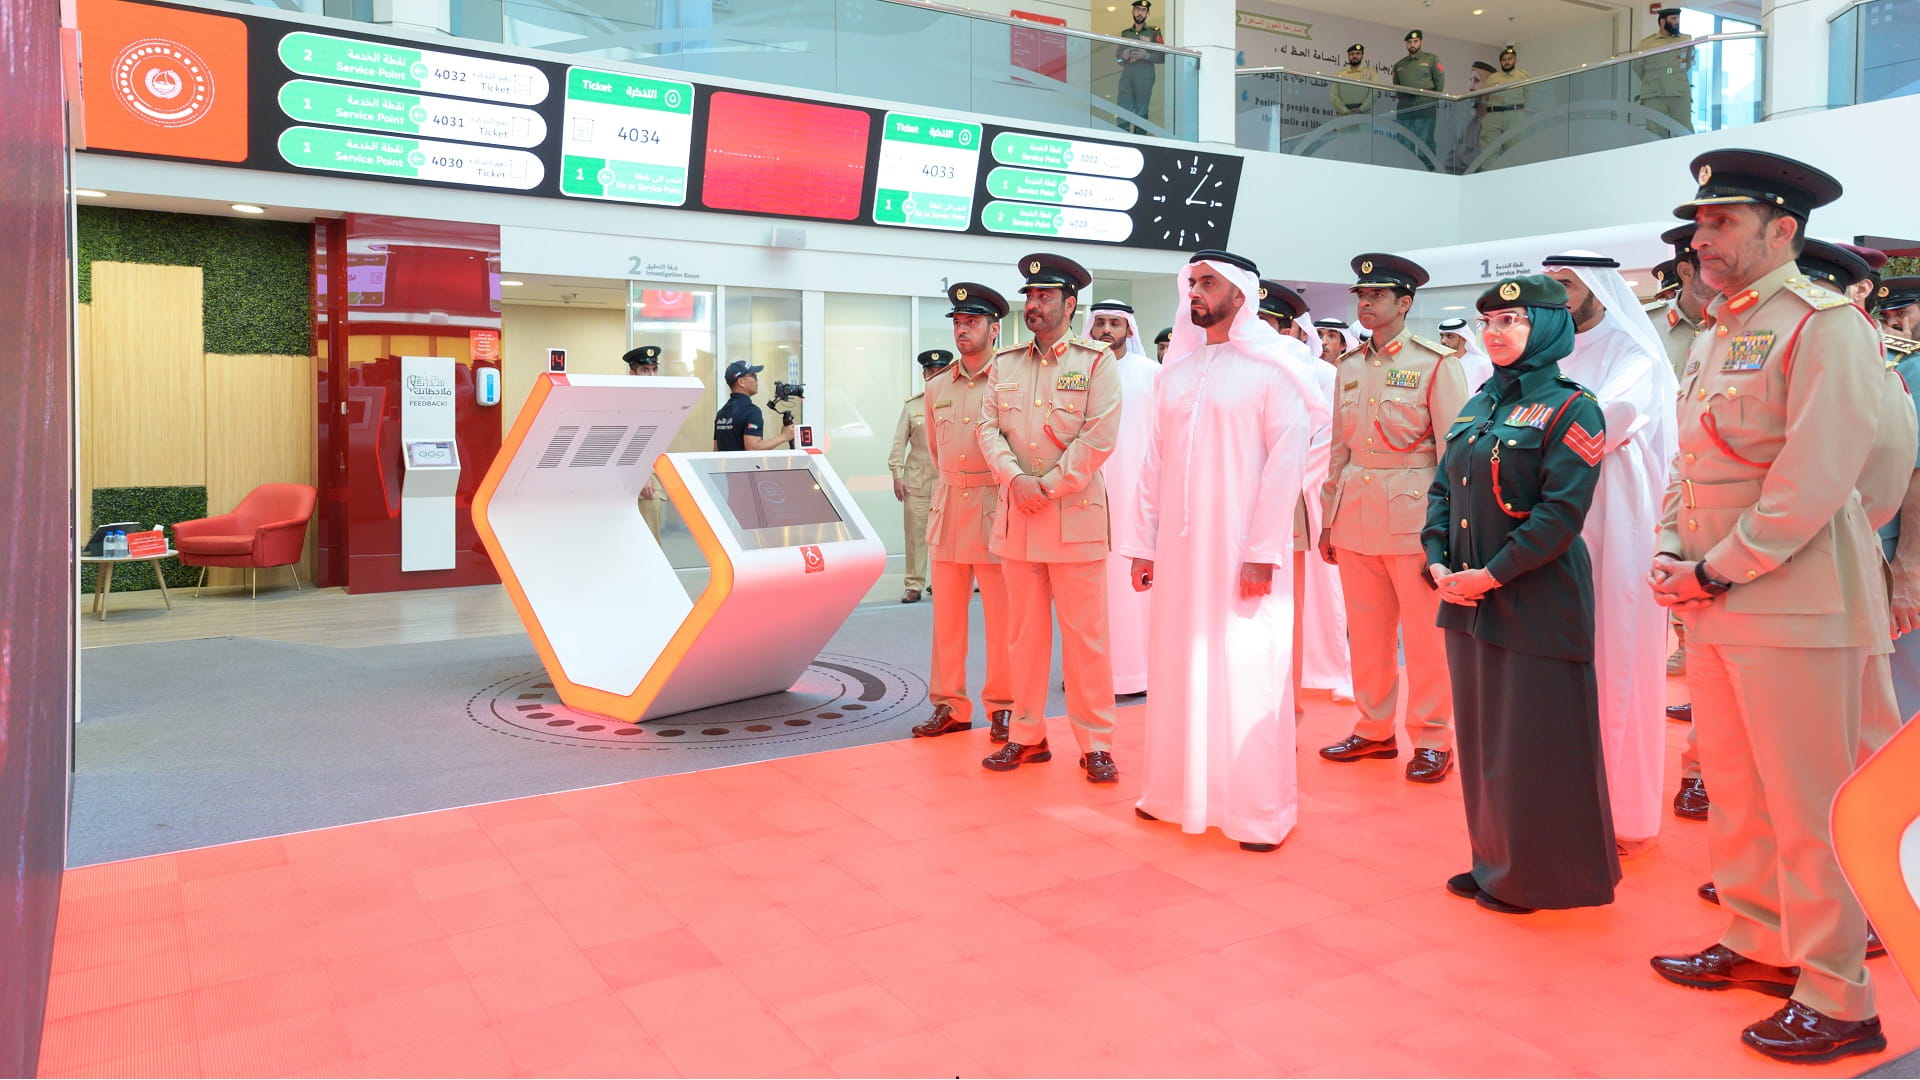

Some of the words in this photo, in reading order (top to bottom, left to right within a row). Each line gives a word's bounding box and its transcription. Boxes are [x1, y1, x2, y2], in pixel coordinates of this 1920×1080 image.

[303, 49, 313, 61] 2
[347, 48, 380, 63] الخدمة
[1291, 46, 1310, 58] الحظ
[383, 54, 406, 67] نقطة
[336, 61, 375, 77] Service
[378, 67, 406, 81] Point
[434, 68, 466, 82] 4032
[481, 82, 510, 94] Ticket
[582, 79, 613, 93] Ticket
[303, 97, 312, 110] 1
[347, 94, 379, 108] الخدمة
[382, 99, 405, 111] نقطة
[335, 107, 374, 121] Service
[377, 112, 405, 125] Point
[1286, 103, 1310, 114] people
[1312, 106, 1320, 115] do
[1322, 109, 1334, 117] not
[432, 114, 465, 128] 4031
[480, 127, 508, 138] Ticket
[896, 122, 919, 134] Ticket
[618, 126, 660, 144] 4034
[303, 141, 312, 153] 1
[346, 138, 378, 152] الخدمة
[381, 143, 403, 154] نقطة
[335, 151, 374, 165] Service
[376, 155, 403, 168] Point
[431, 156, 463, 169] 4030
[1022, 152, 1044, 162] Service
[1045, 155, 1061, 164] Point
[477, 168, 505, 178] Ticket
[575, 167, 585, 181] 1
[922, 164, 955, 179] 4033
[1190, 167, 1197, 175] 12
[1017, 185, 1039, 195] Service
[1039, 188, 1056, 197] Point
[884, 199, 892, 210] 1
[1161, 195, 1166, 203] 9
[1210, 200, 1215, 208] 3
[1012, 218, 1034, 227] Service
[1035, 220, 1051, 229] Point
[1180, 229, 1185, 237] 6
[628, 255, 642, 275] 2
[1480, 259, 1492, 278] 1
[940, 276, 948, 293] 1
[552, 354, 564, 368] 14
[800, 429, 812, 443] 13
